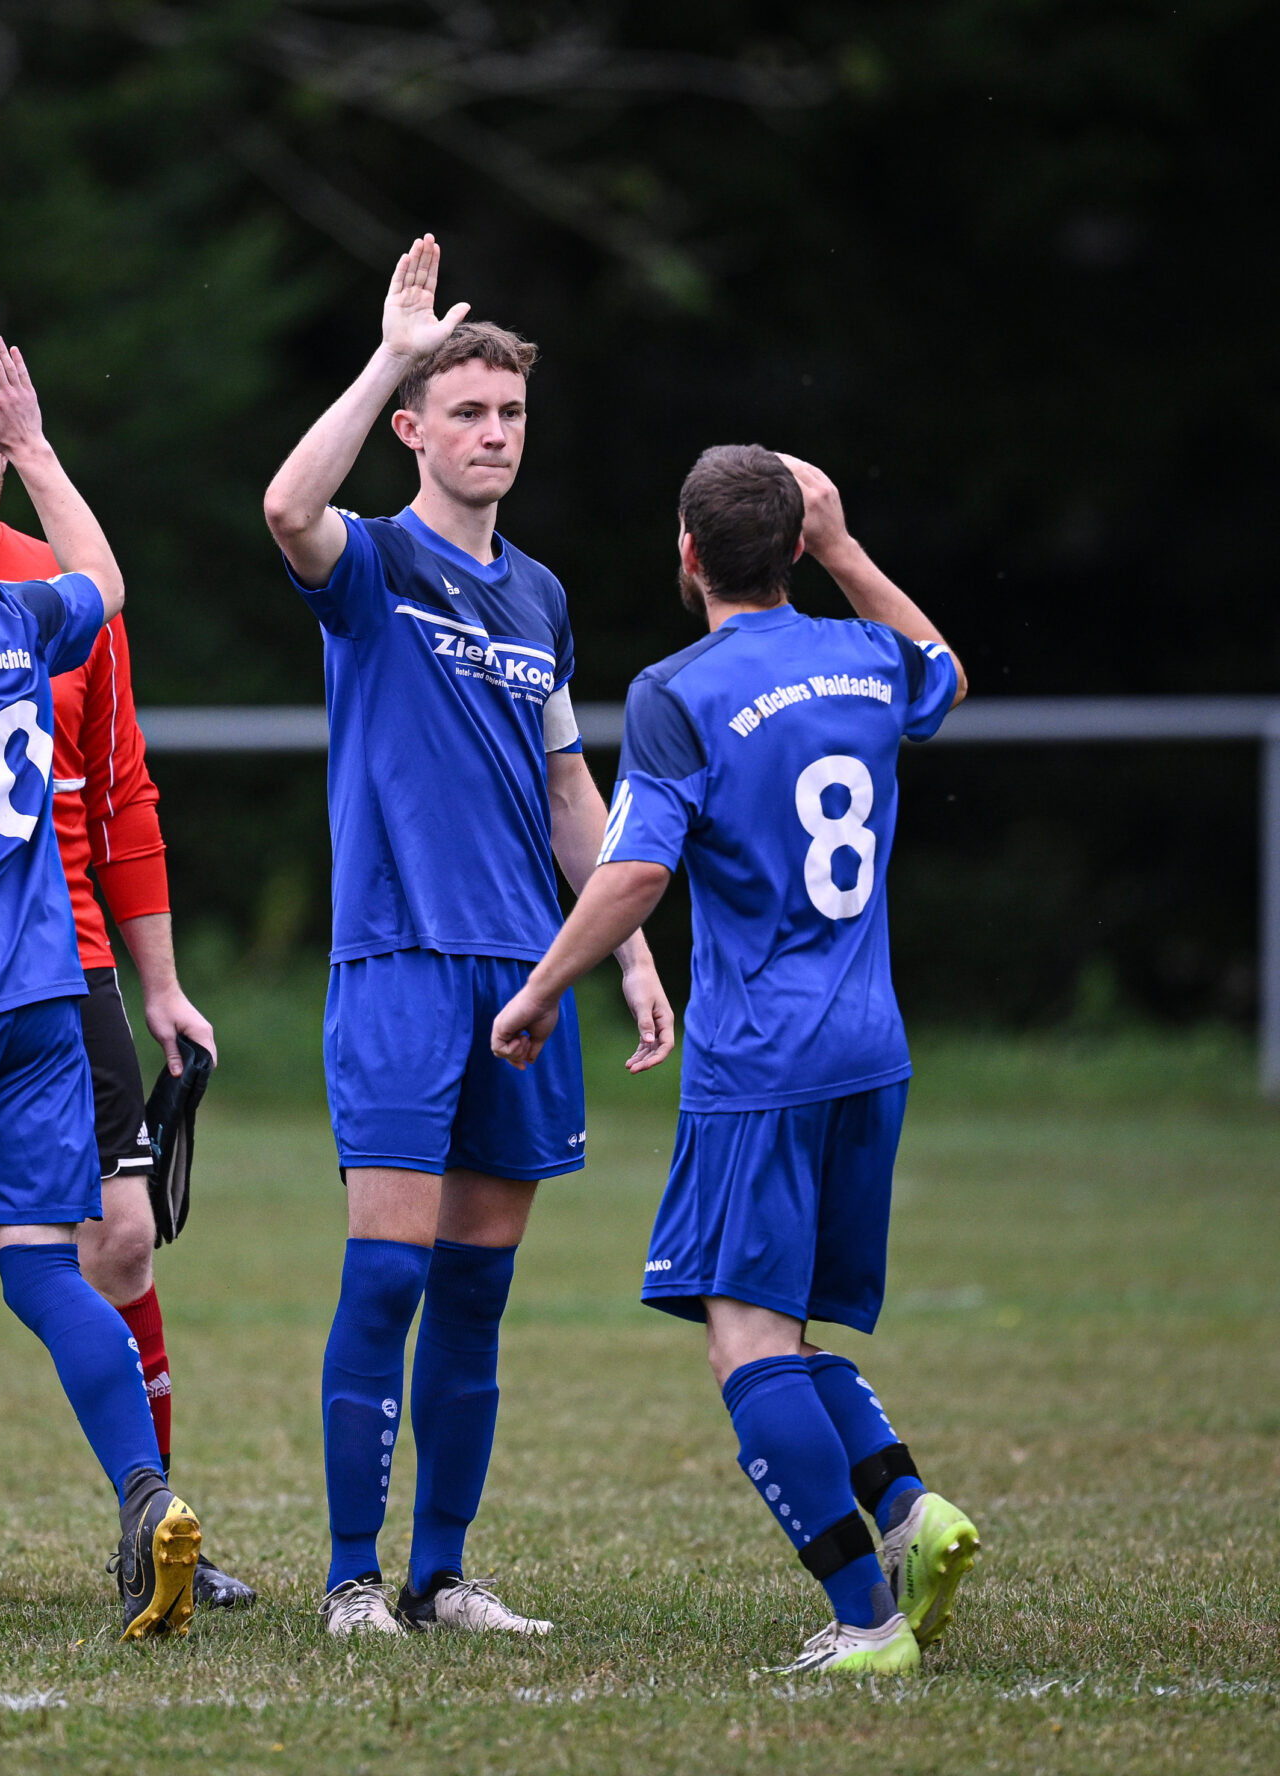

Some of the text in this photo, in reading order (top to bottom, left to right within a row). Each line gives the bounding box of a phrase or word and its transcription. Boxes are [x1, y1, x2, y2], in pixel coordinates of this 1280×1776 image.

[728, 674, 892, 738] VfB Kickers Waldachtal
[794, 754, 877, 920] 8
